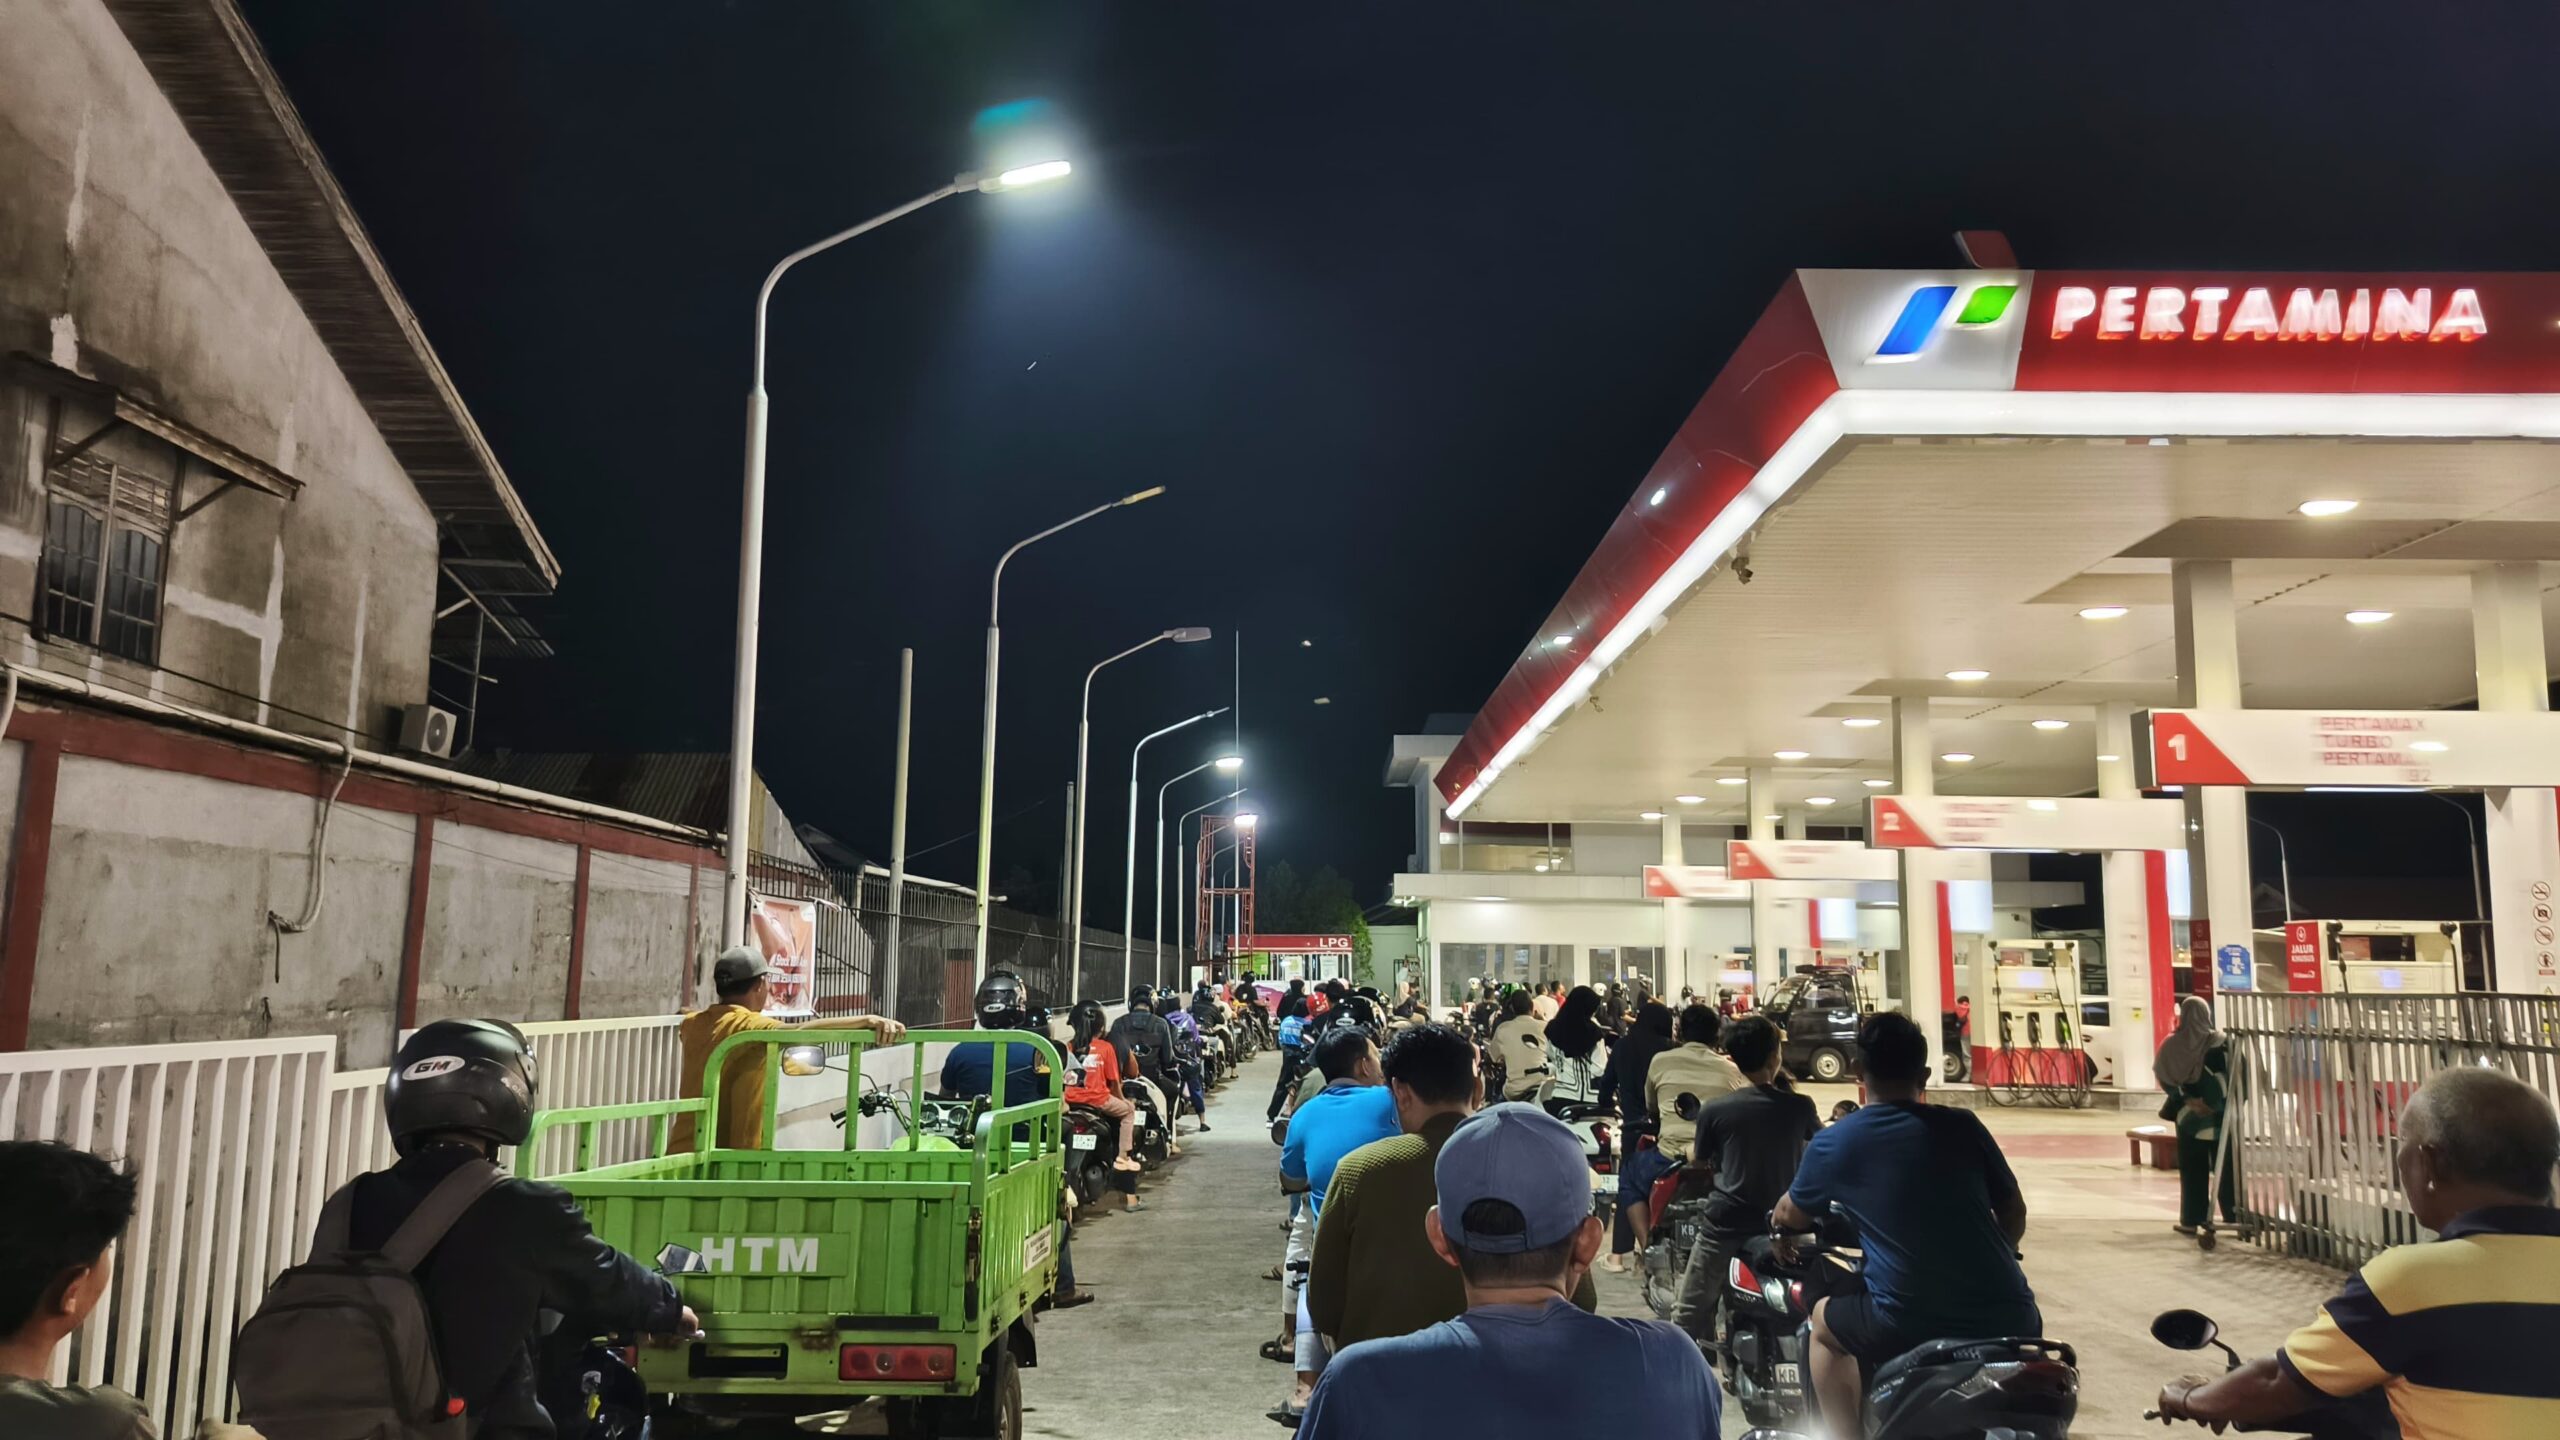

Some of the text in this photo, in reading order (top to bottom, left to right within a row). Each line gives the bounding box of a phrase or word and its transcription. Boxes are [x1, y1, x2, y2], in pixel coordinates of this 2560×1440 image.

[2054, 286, 2488, 339] PERTAMINA
[2319, 717, 2425, 731] PERTAMAX
[2168, 733, 2187, 761] 1
[2320, 734, 2393, 748] TURBO
[2323, 752, 2429, 766] PERTAMA
[1882, 812, 1900, 831] 2
[1319, 937, 1348, 948] LPG
[2291, 944, 2314, 954] JALUR
[414, 1061, 452, 1073] GM
[1681, 1224, 1695, 1236] KB
[701, 1237, 819, 1272] HTM
